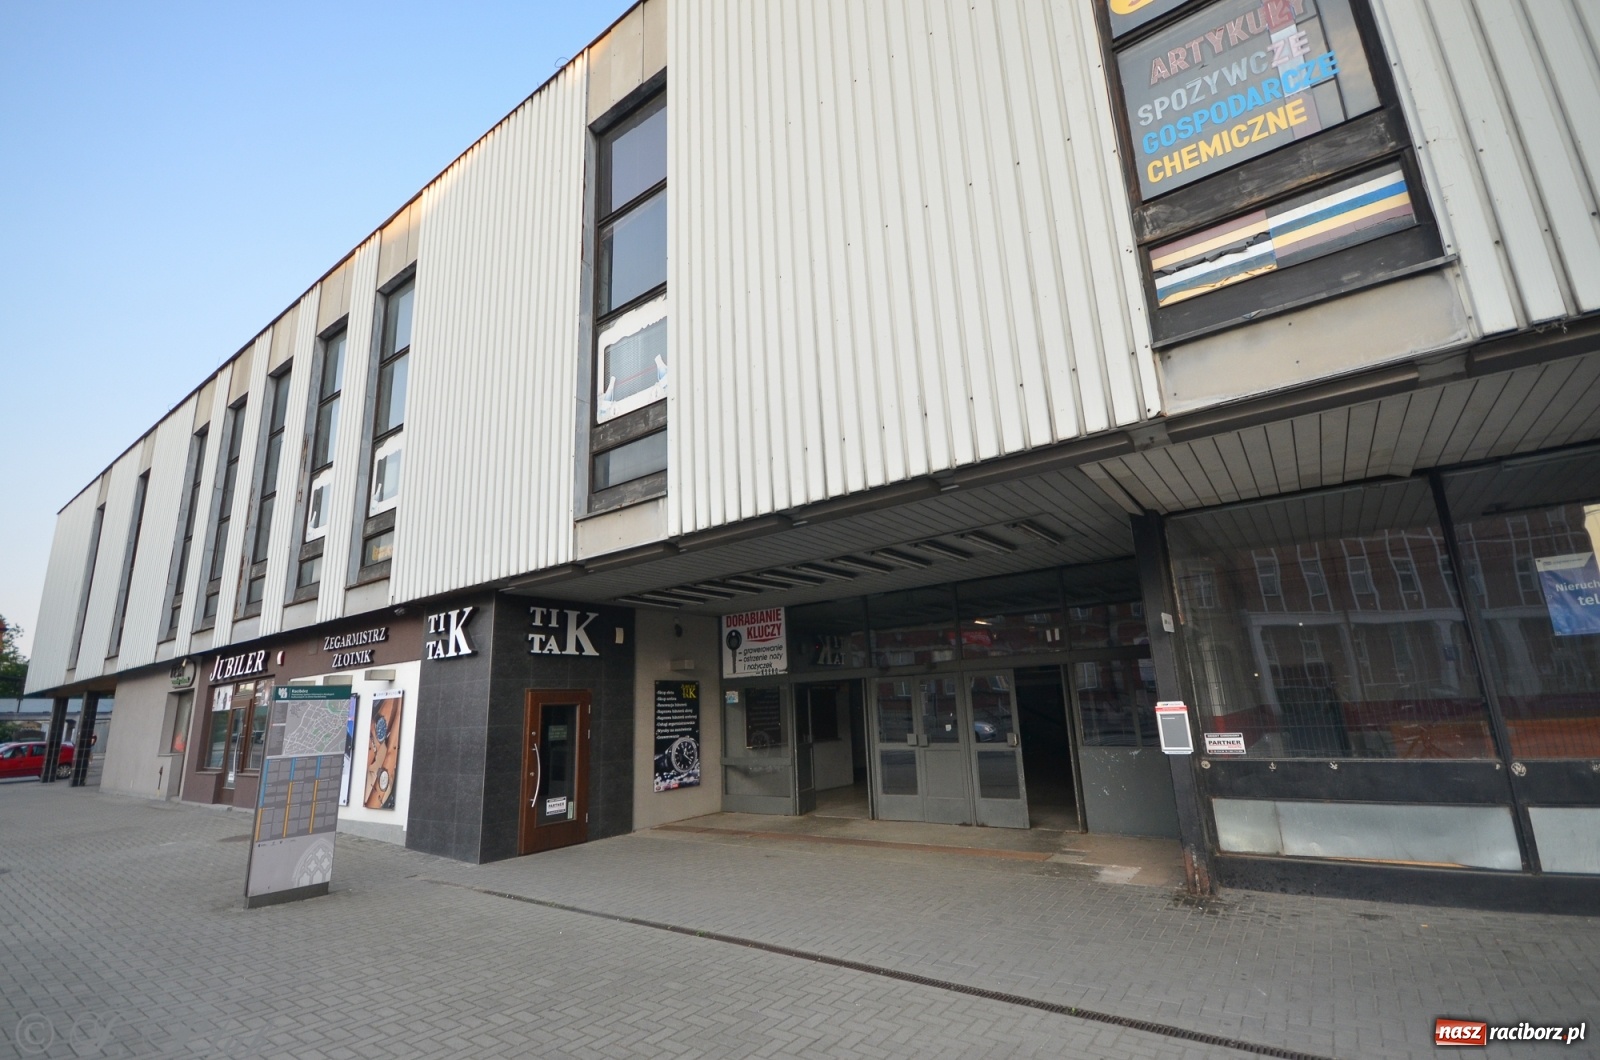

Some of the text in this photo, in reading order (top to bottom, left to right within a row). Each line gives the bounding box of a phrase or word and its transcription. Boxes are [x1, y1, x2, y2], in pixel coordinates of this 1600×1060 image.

[1142, 50, 1340, 154] GOSPODARCZE
[1147, 98, 1308, 183] CHEMICZNE
[726, 608, 782, 628] DORABIANIE
[323, 627, 386, 650] ZEGARMISTRZ
[747, 623, 782, 640] KLUCZY
[743, 644, 783, 656] grawerowanie
[743, 654, 768, 662] ostrzenie
[209, 650, 265, 682] JUBILER
